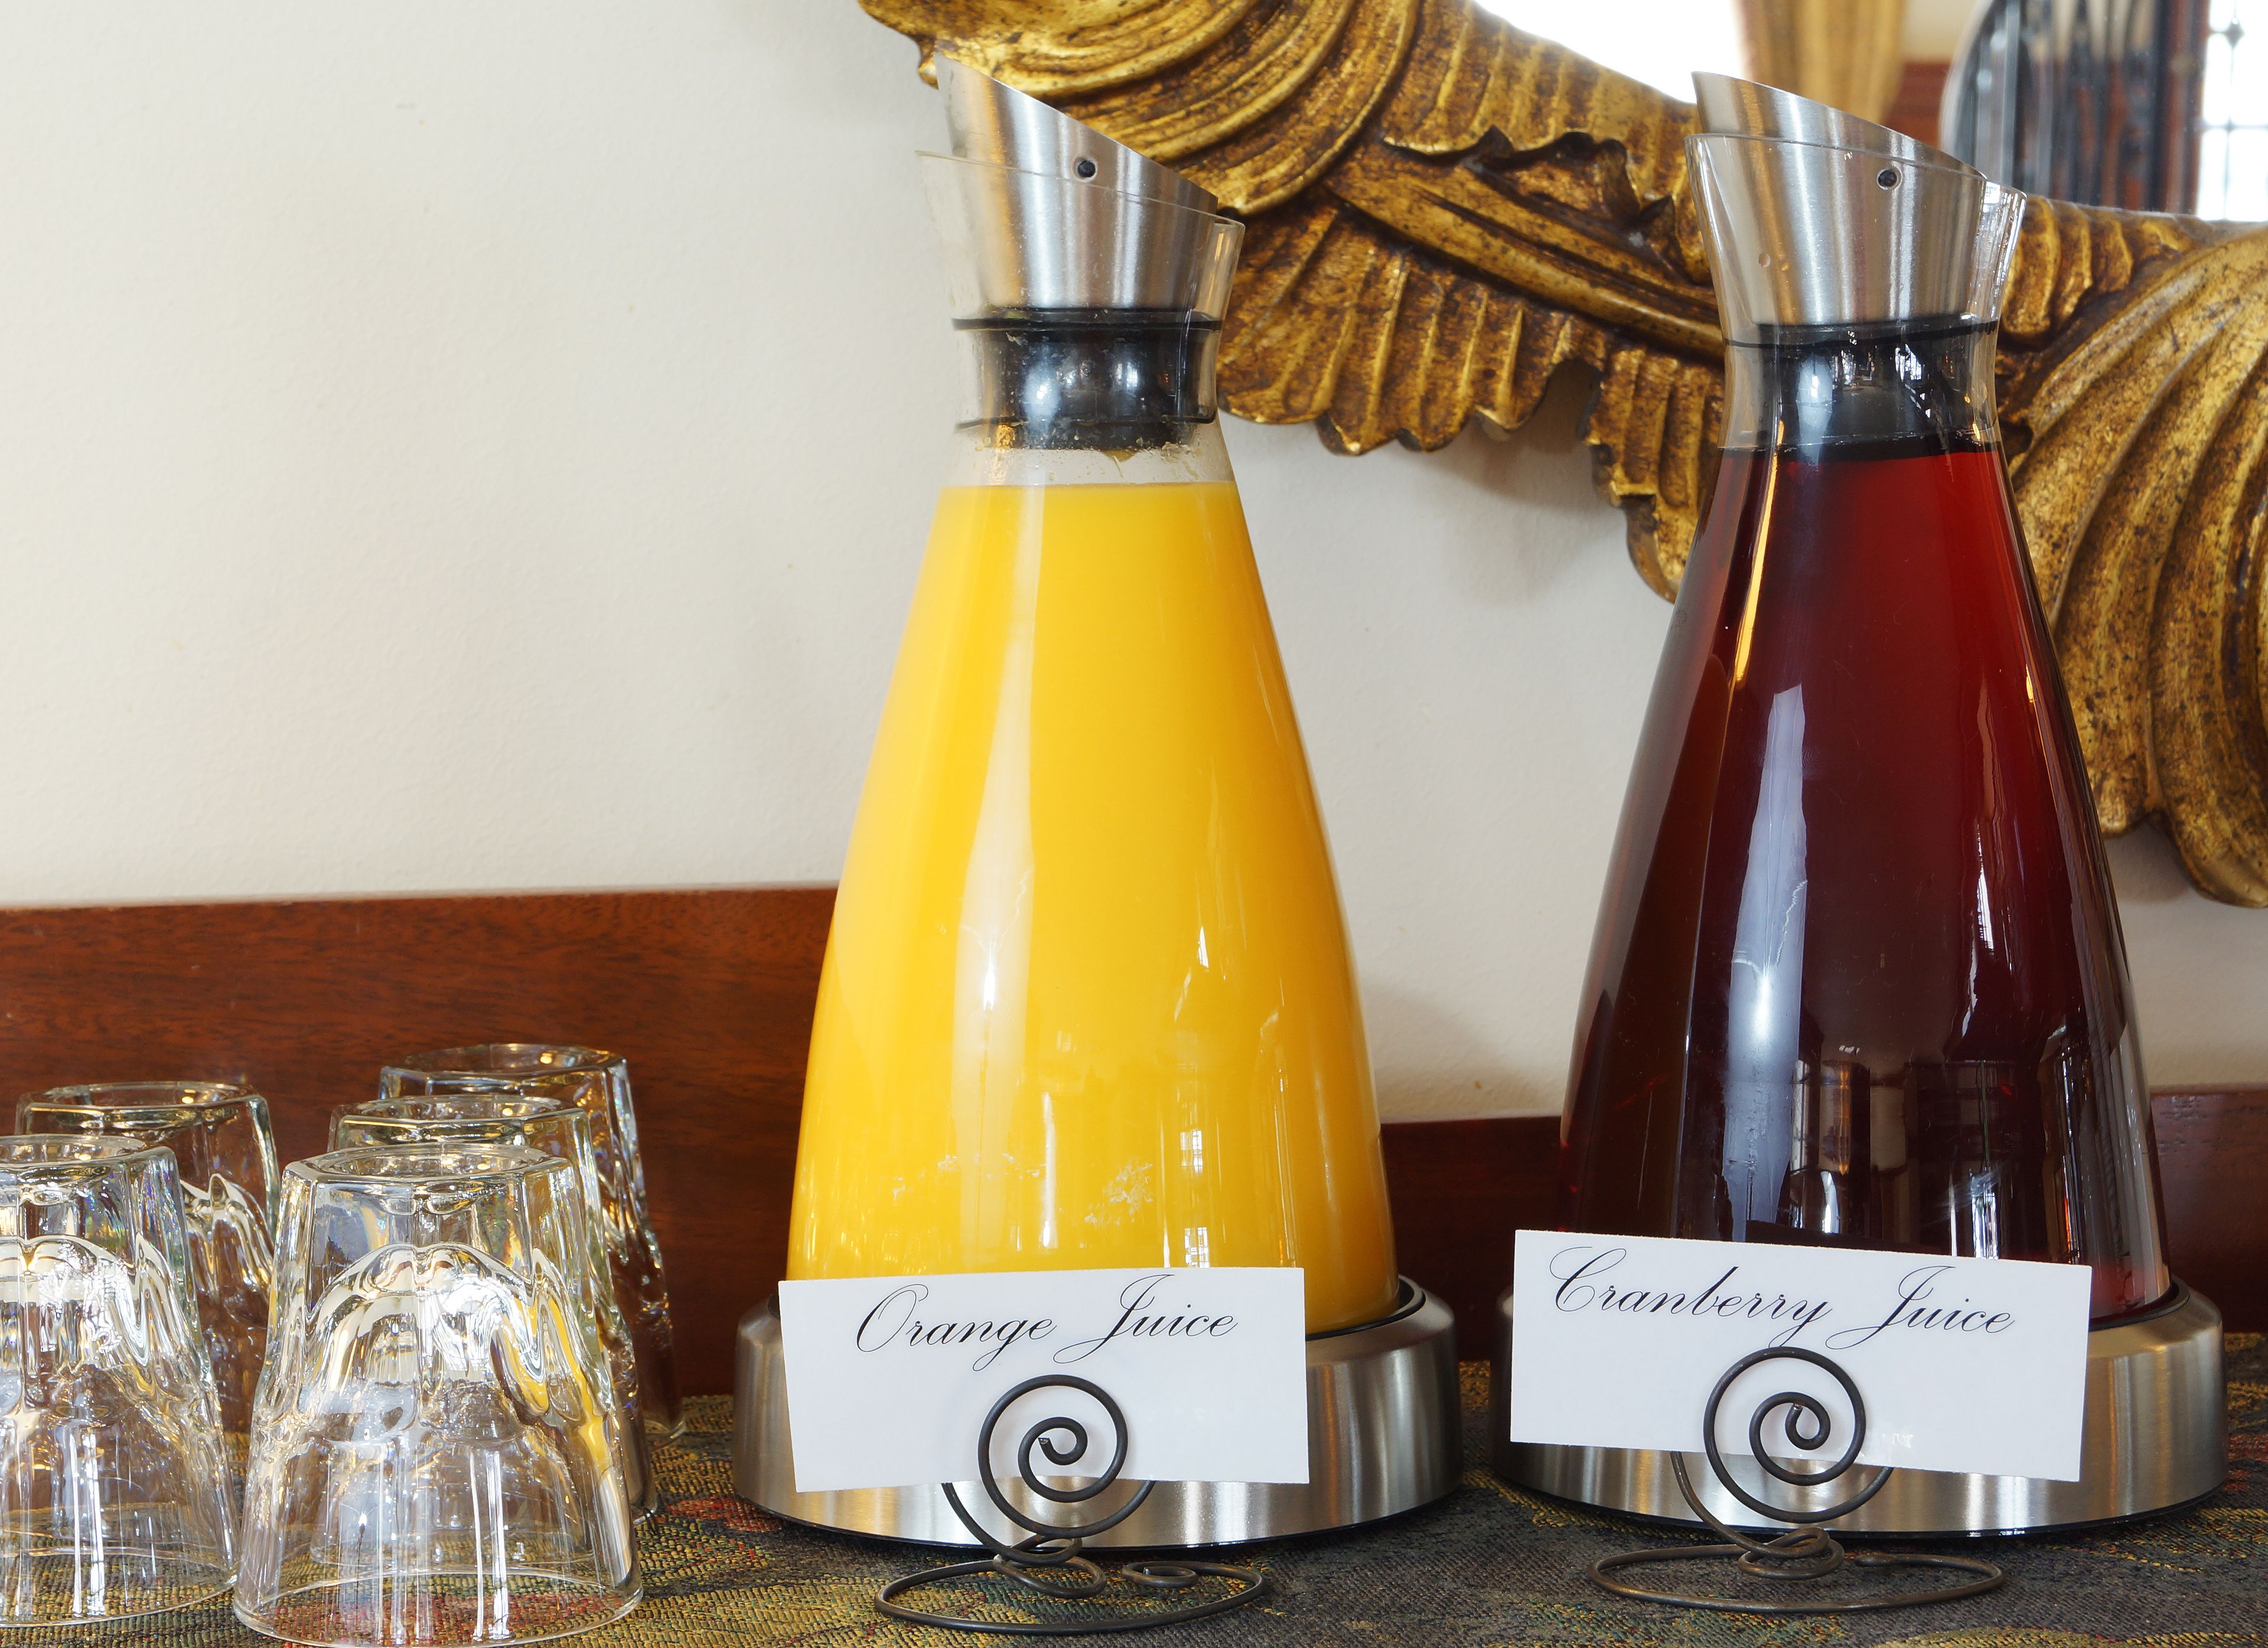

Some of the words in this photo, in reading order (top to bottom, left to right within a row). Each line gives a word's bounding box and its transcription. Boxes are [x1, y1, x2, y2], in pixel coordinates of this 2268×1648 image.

[856, 1283, 1057, 1372] Orange
[1052, 1273, 1239, 1364] Juice
[1549, 1246, 1833, 1349] Cranberry
[1825, 1265, 2015, 1350] Juice
